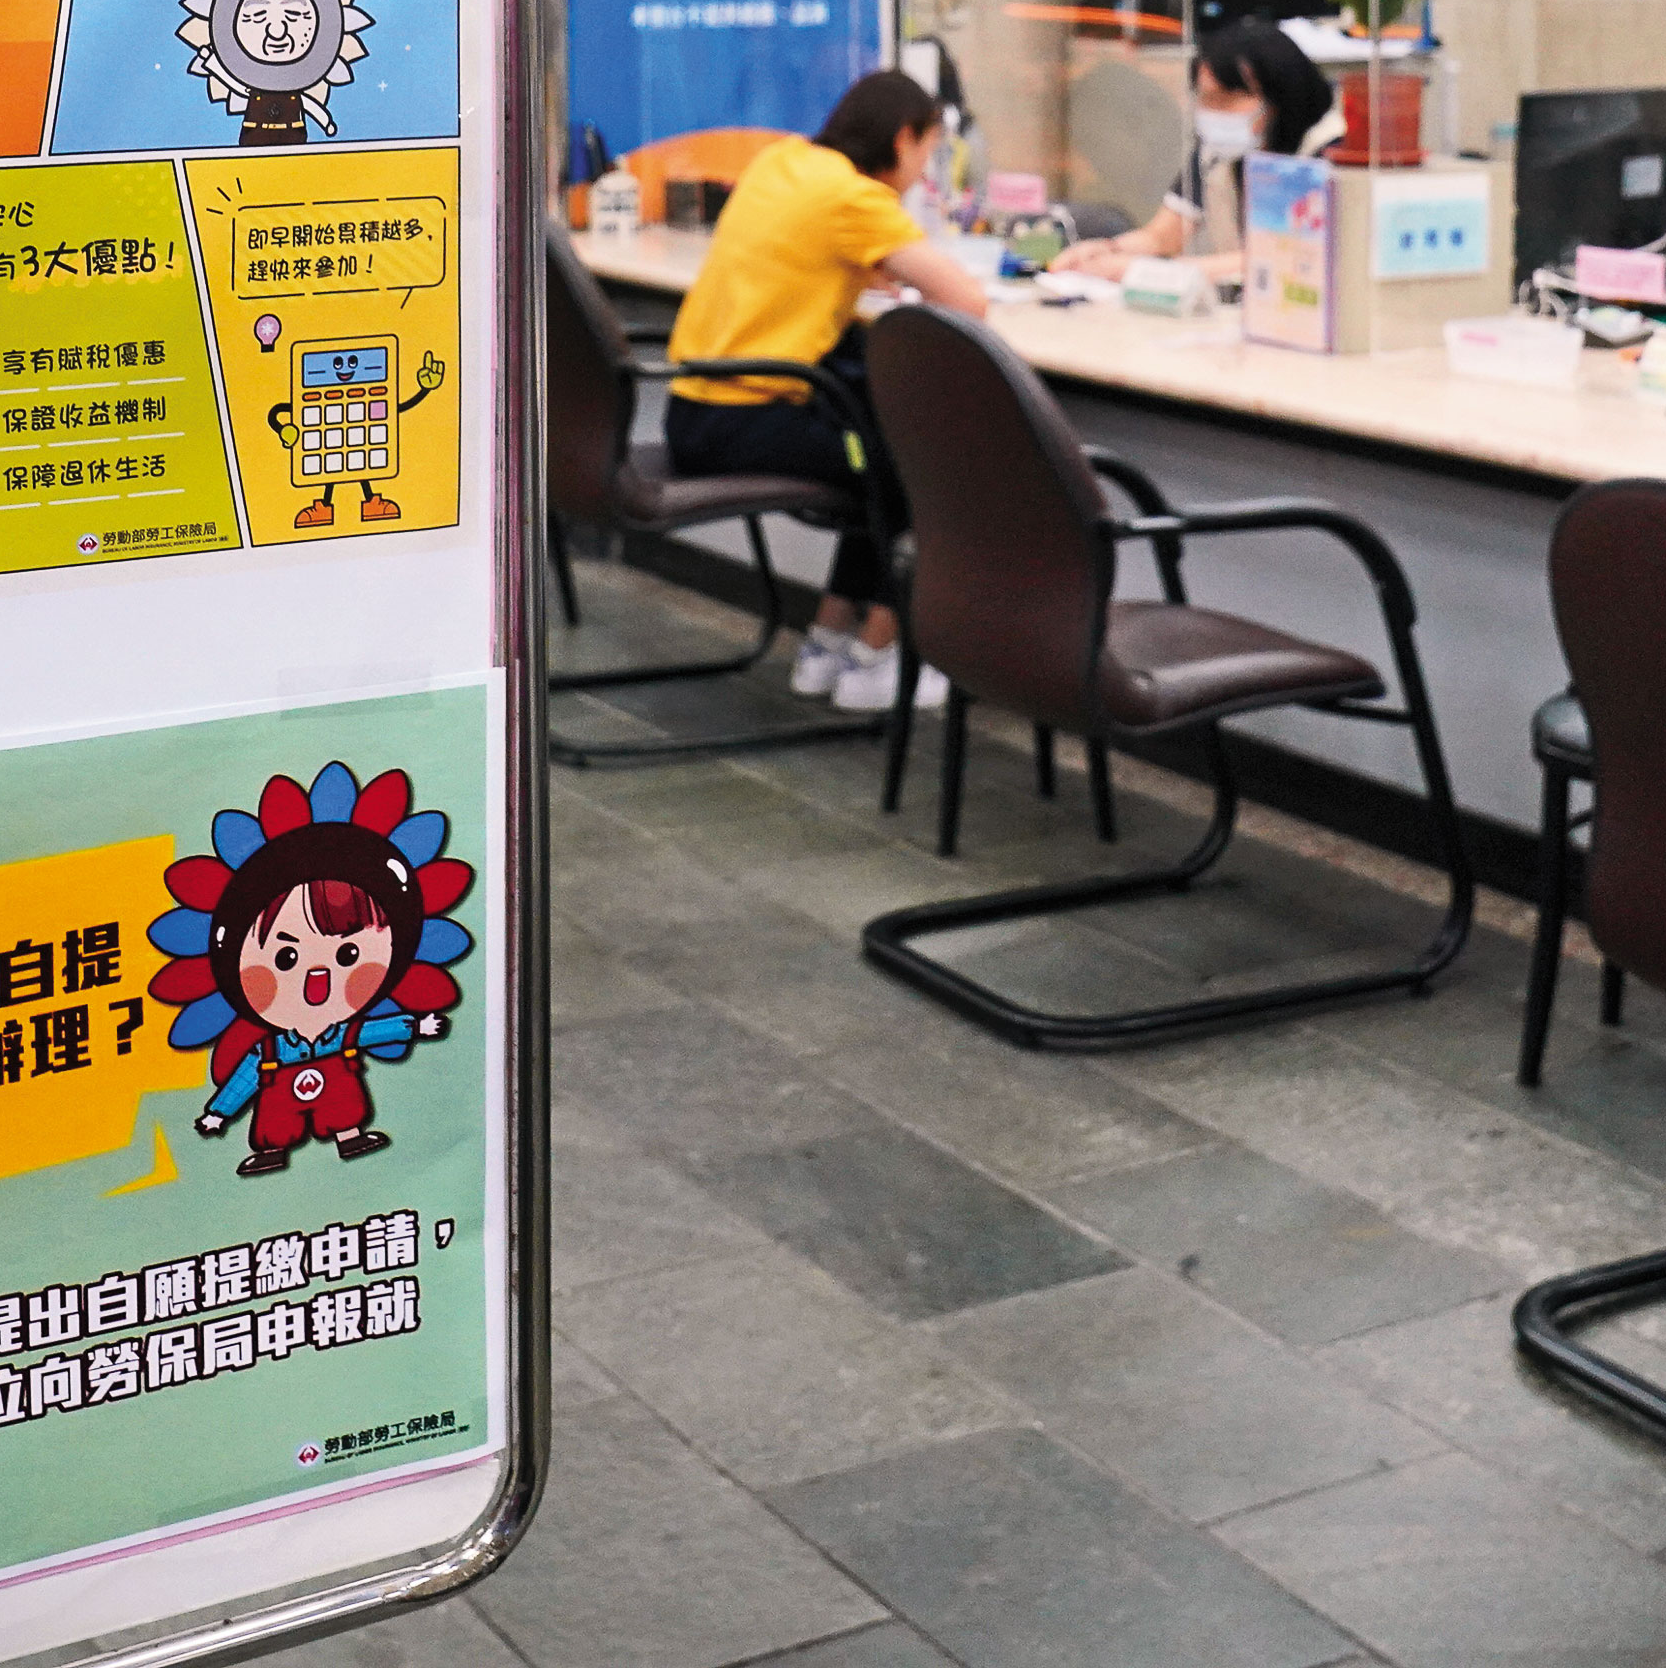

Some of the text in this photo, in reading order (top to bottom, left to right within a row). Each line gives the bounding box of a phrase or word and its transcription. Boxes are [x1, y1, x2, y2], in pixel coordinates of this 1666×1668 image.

[2, 339, 167, 376] 享有賦稅優惠
[2, 396, 167, 434] 保證收益機制
[2, 454, 166, 492] 保障退休生活
[102, 522, 217, 547] 勞動部勞工保險局
[324, 1410, 456, 1456] 勞動部勞工保險局
